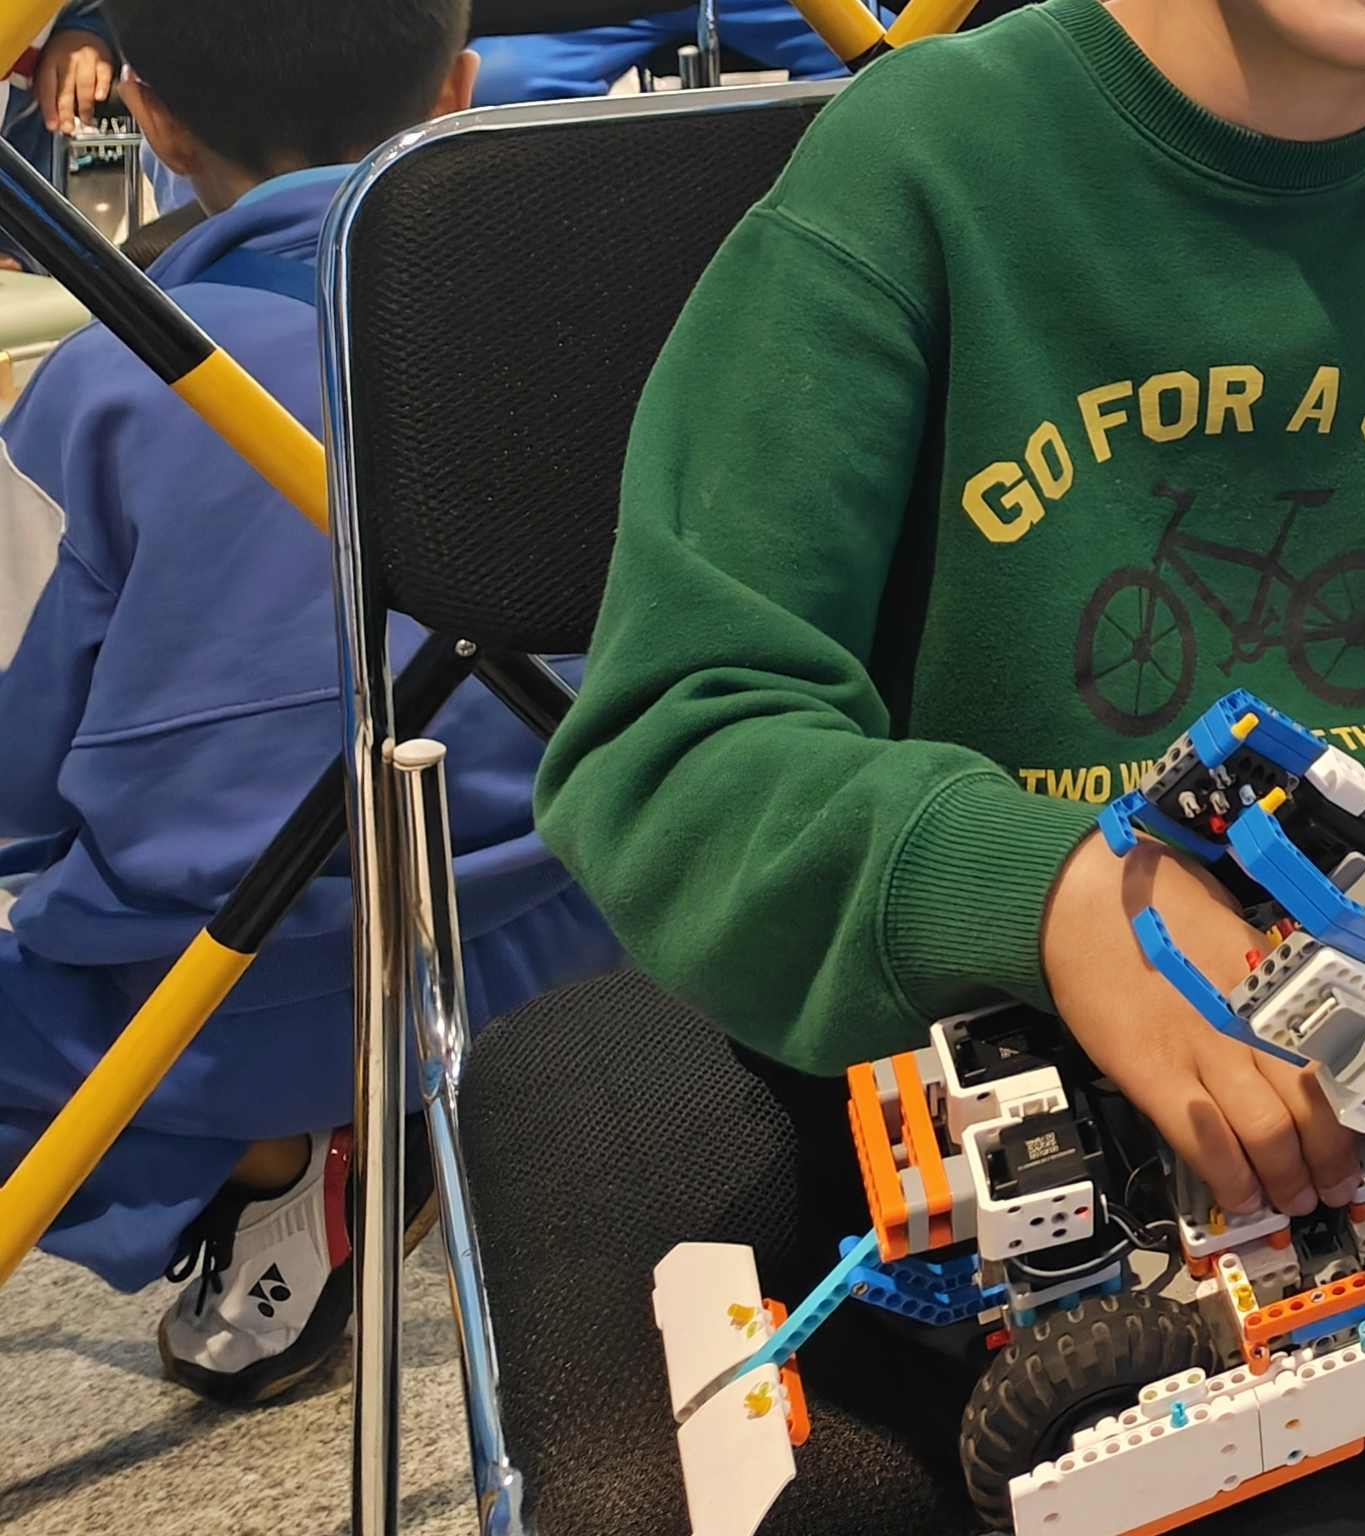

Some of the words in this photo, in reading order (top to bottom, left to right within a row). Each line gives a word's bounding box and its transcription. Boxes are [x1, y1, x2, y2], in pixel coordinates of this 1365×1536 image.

[961, 419, 1075, 544] GO
[1076, 364, 1265, 464] FOR
[1286, 365, 1341, 435] A
[1018, 765, 1113, 804] TWO
